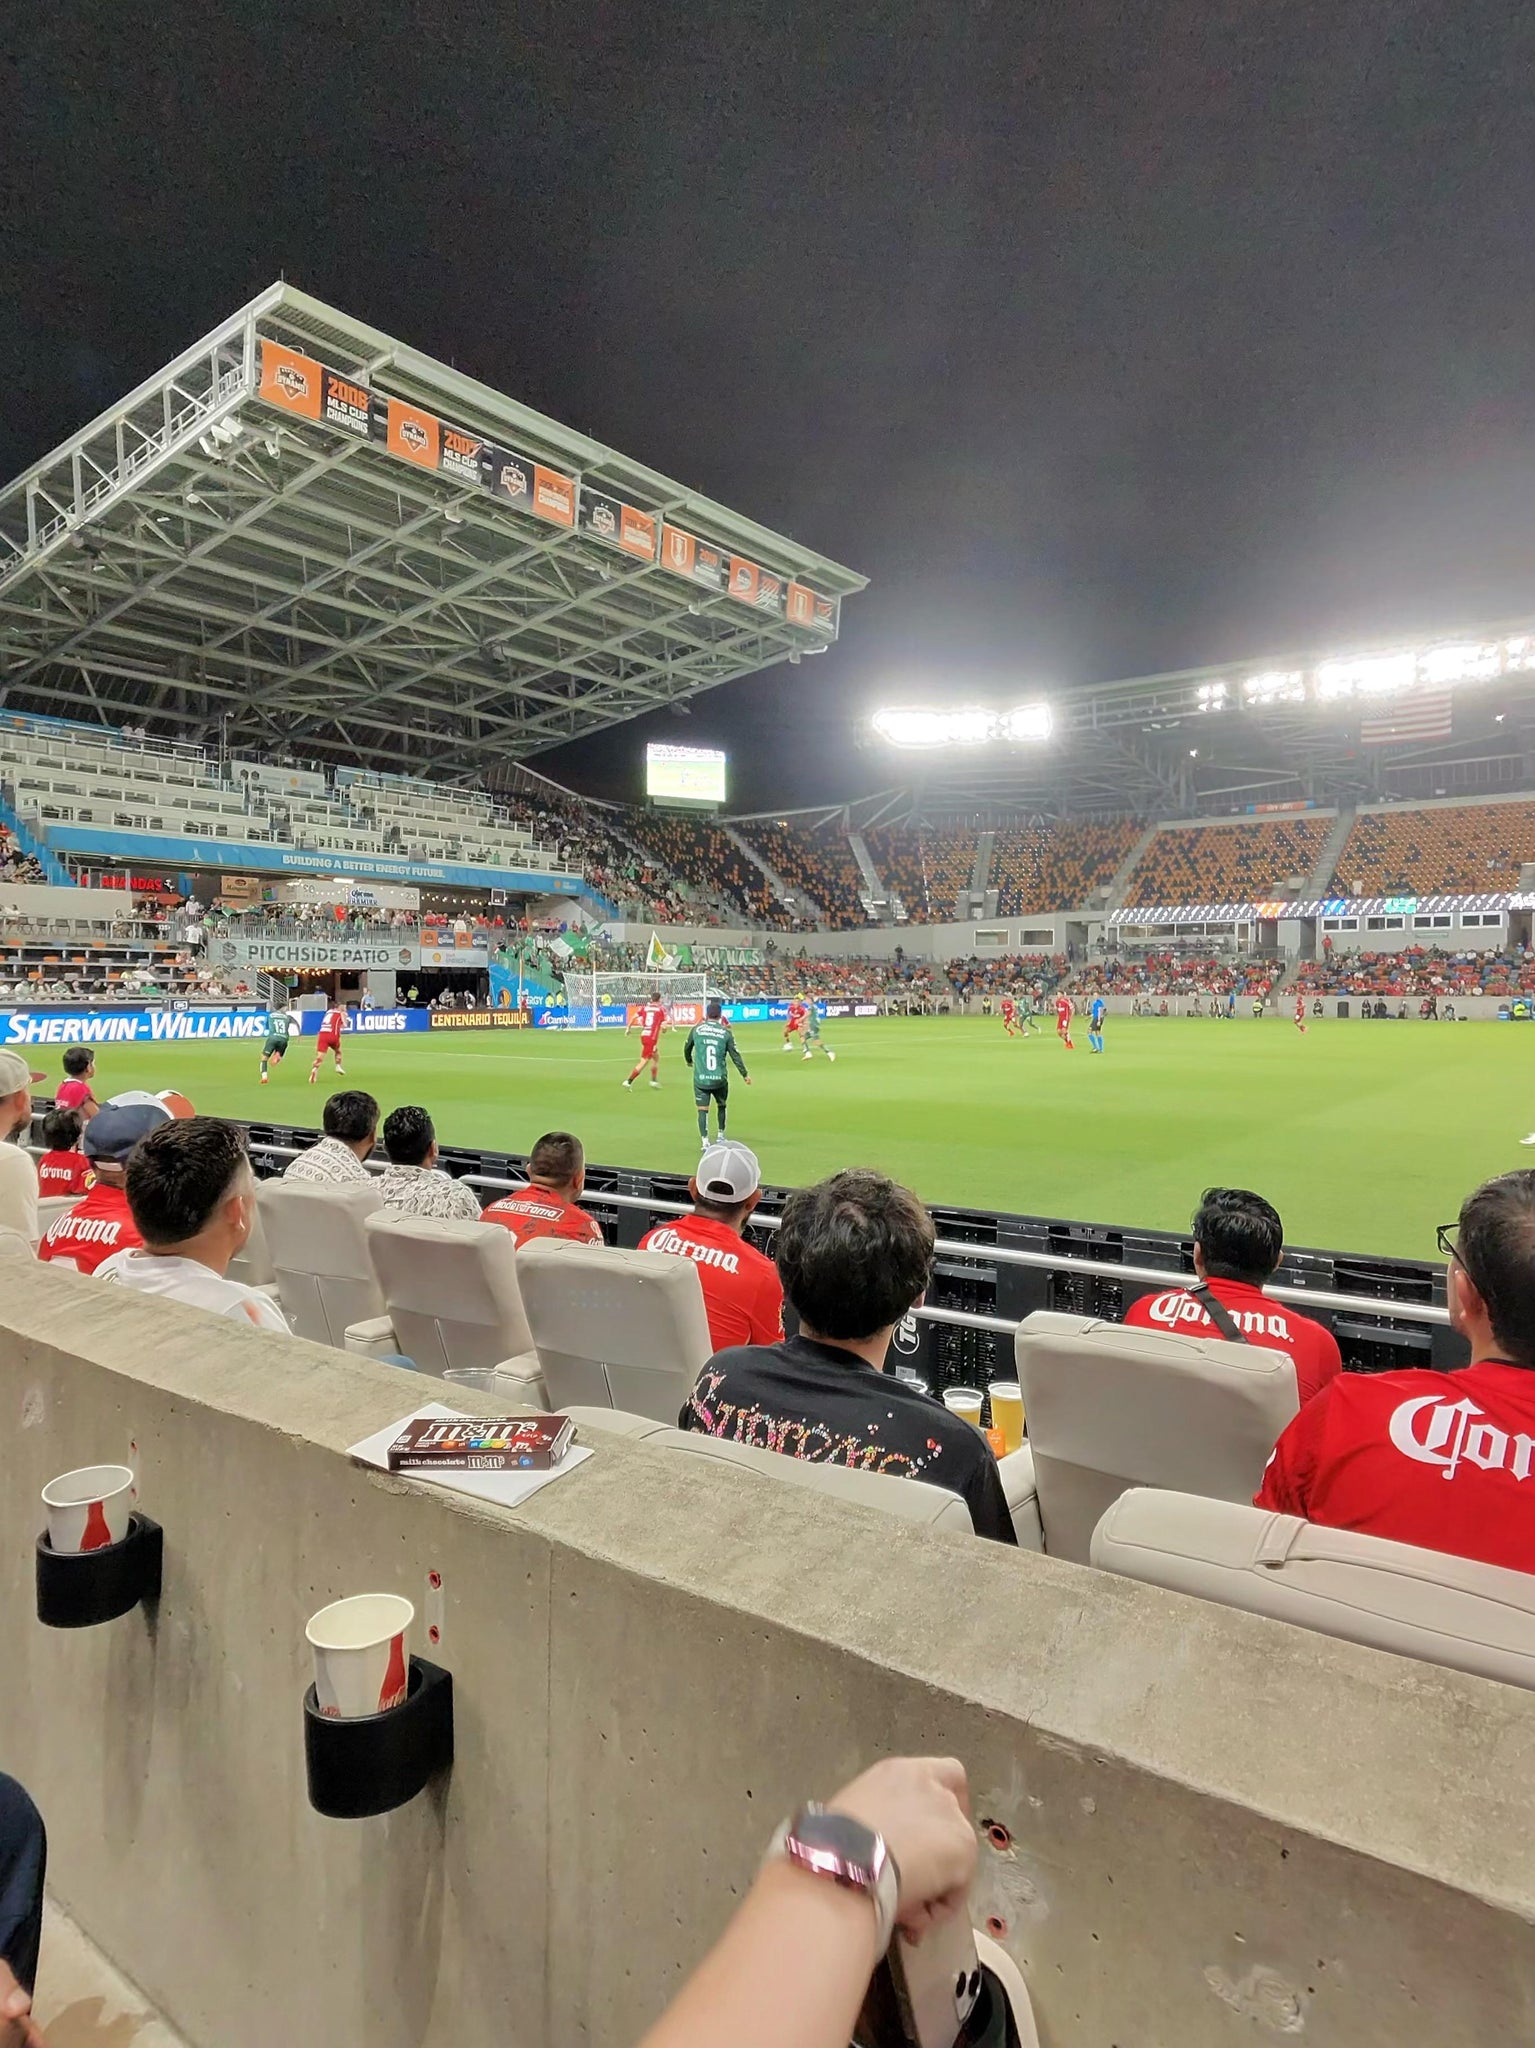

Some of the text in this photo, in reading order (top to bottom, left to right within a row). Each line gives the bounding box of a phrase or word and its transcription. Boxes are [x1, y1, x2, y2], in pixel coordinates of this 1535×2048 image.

[327, 396, 369, 421] MLS CUP
[326, 406, 369, 434] CHAMPIONS
[443, 448, 478, 468] MLS CUP
[282, 854, 333, 868] BUILDING
[333, 860, 342, 869] A
[342, 860, 375, 872] BETTER
[375, 864, 411, 876] ENERGY
[342, 949, 390, 963] PATIO
[517, 996, 544, 1005] EERGY
[273, 1018, 286, 1034] 13
[431, 1013, 491, 1027] CENTENARIO
[598, 1014, 624, 1023] Carnival
[706, 1045, 717, 1071] 6
[422, 1458, 466, 1466] chocolate
